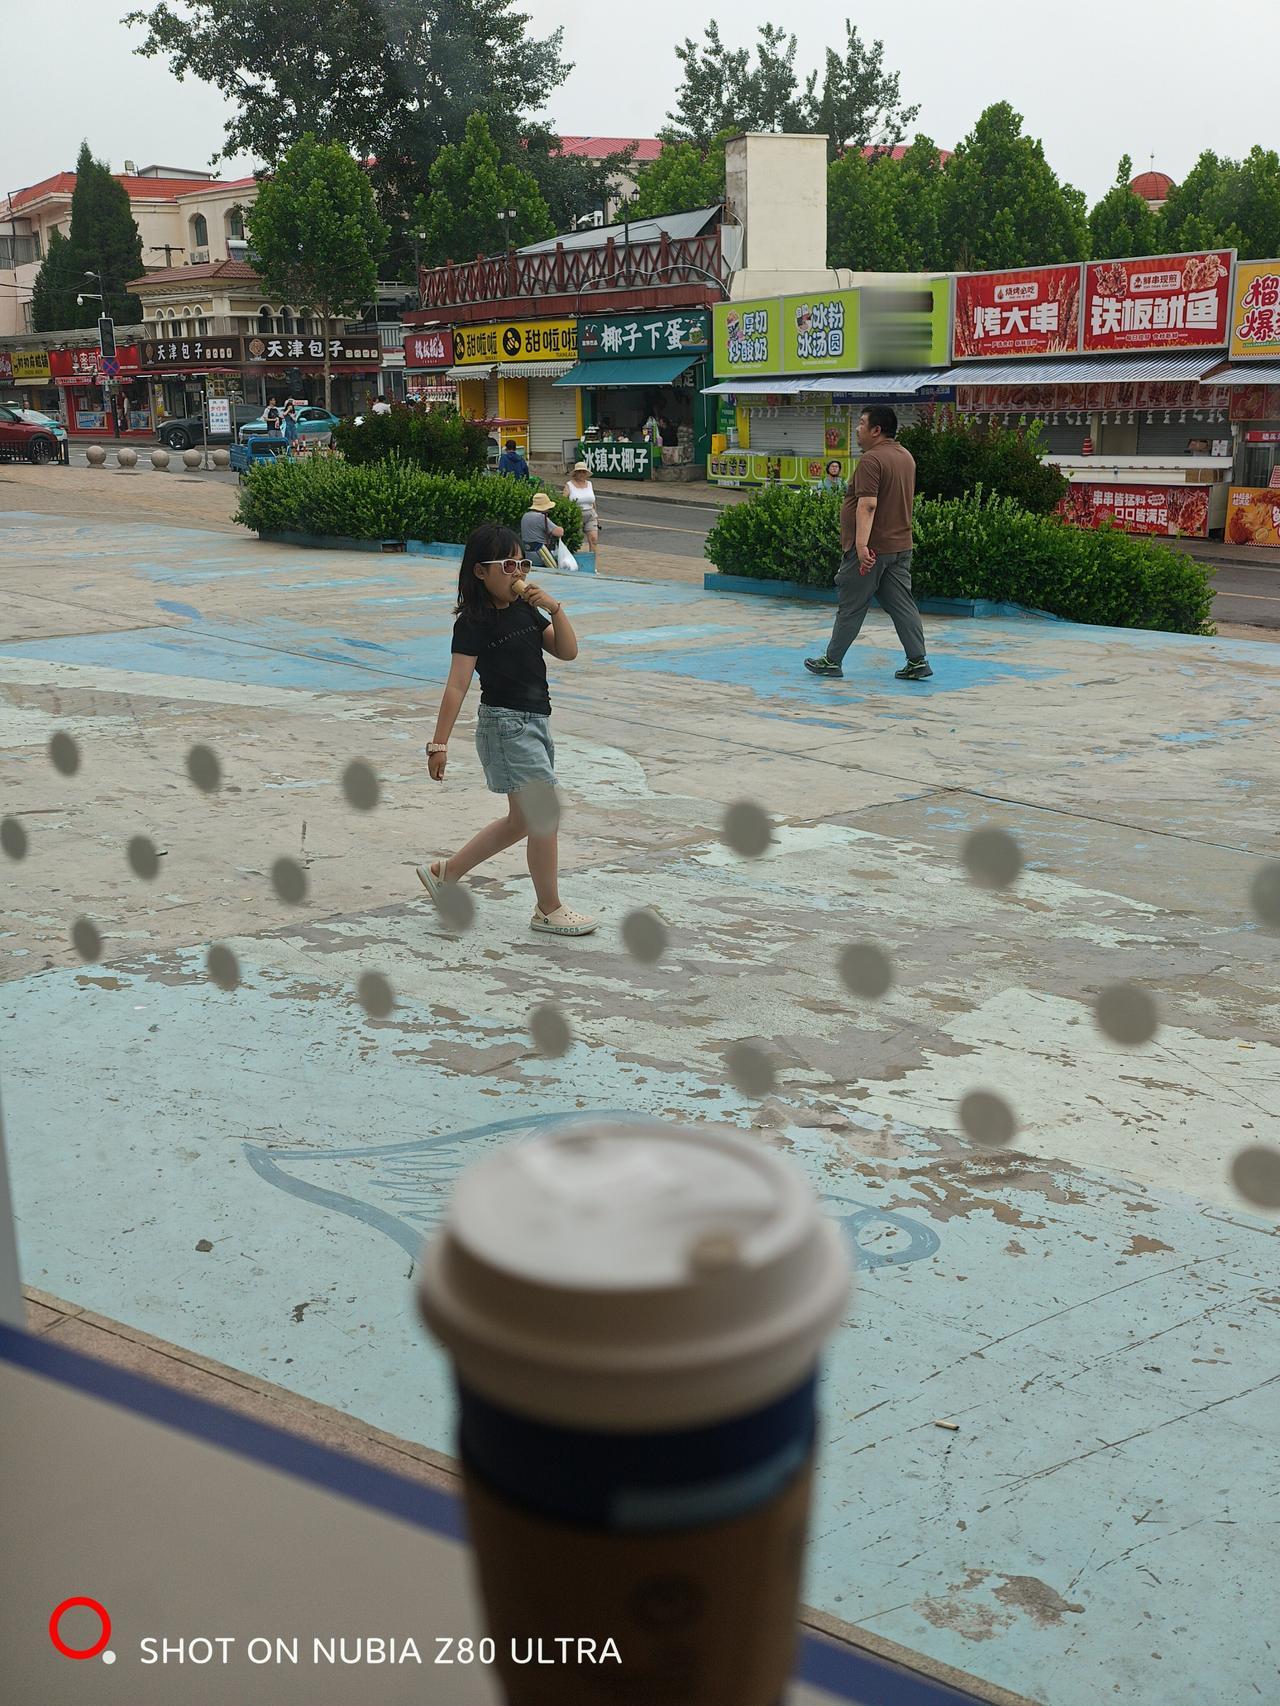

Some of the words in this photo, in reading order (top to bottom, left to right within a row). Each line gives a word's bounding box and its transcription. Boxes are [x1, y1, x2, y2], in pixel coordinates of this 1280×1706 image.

[743, 310, 768, 336] 厚切
[812, 301, 845, 329] 冰粉
[974, 302, 1059, 339] 烤大串
[1091, 288, 1218, 335] 铁板鱿鱼
[467, 332, 498, 357] 甜啦啦
[525, 328, 578, 353] 甜啦啦
[601, 317, 687, 353] 椰子下蛋
[797, 330, 843, 358] 冰汤圆
[157, 342, 203, 361] 天津包子
[267, 339, 344, 359] 天津包子
[728, 337, 768, 363] 炒酸奶
[582, 447, 648, 473] 冰镇大椰子
[1092, 490, 1145, 507] 串串皆猛料
[1114, 508, 1168, 526] 口口皆满足
